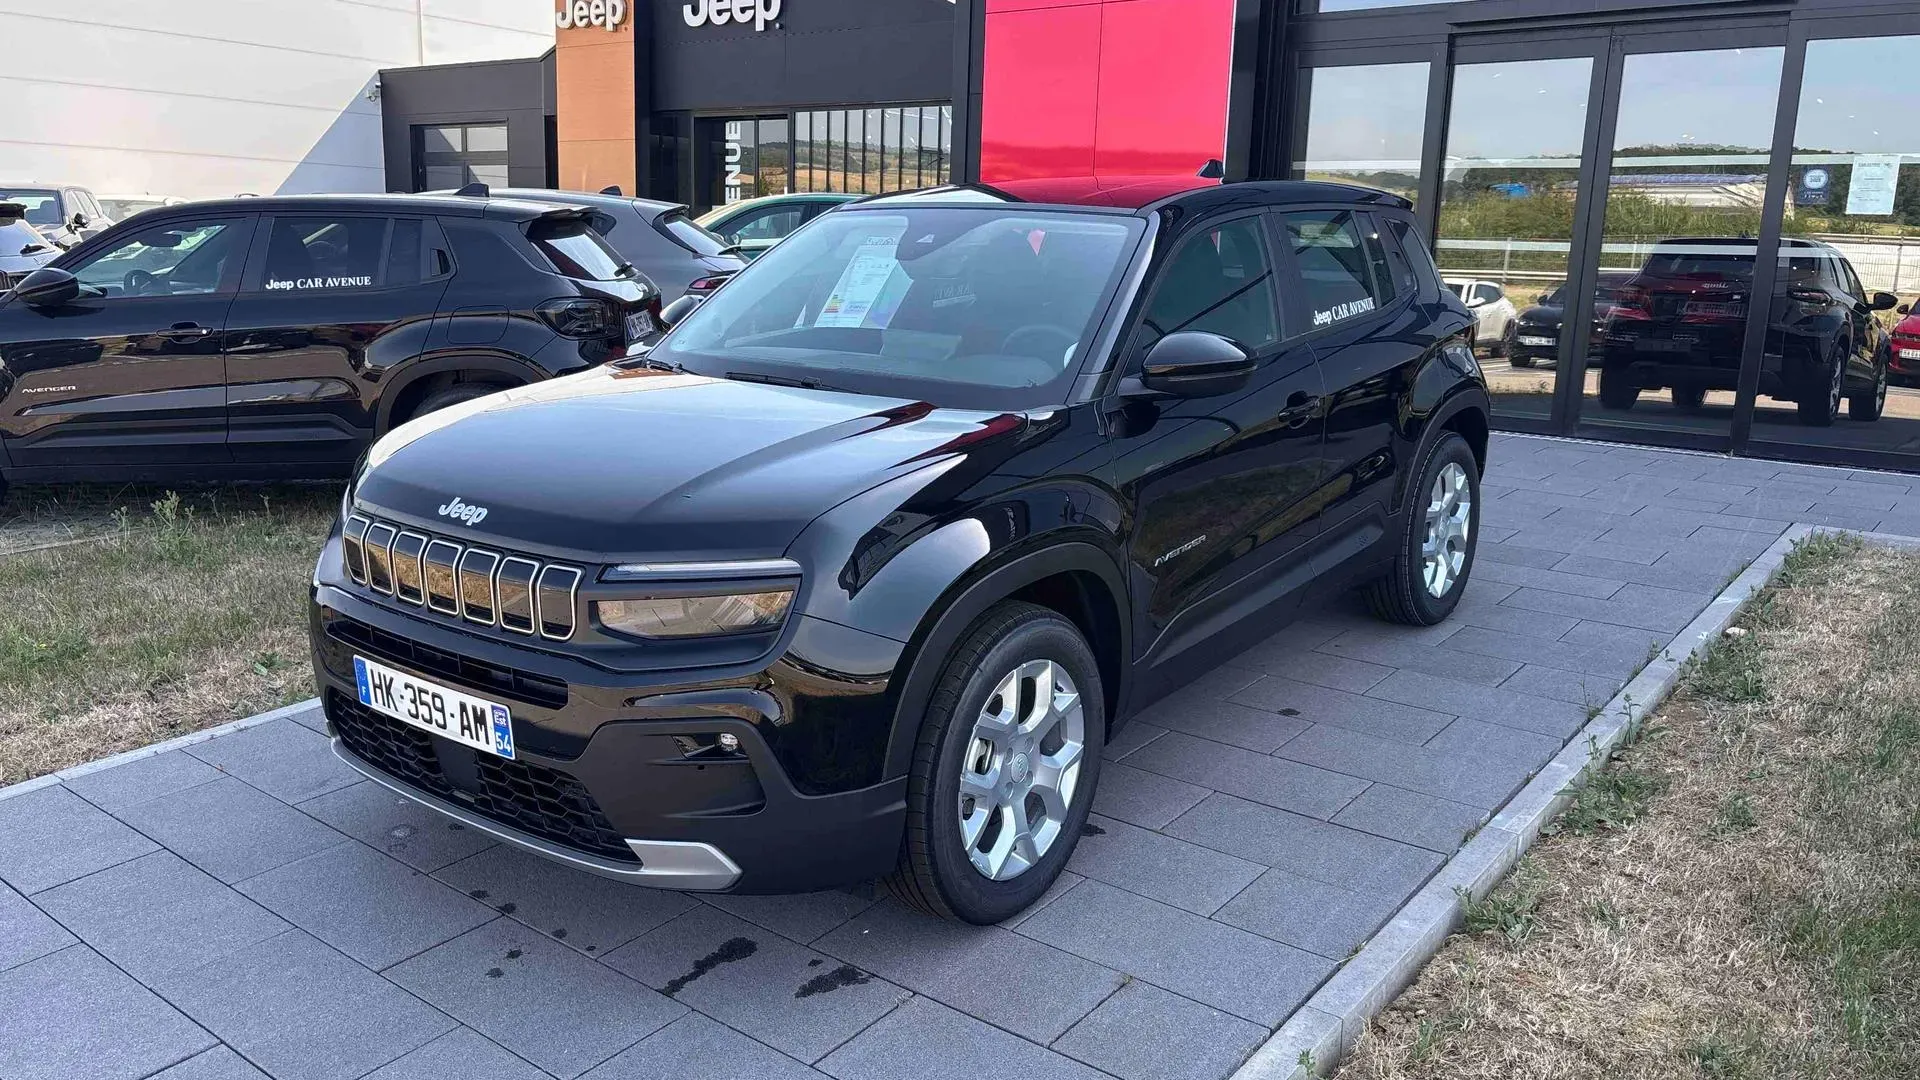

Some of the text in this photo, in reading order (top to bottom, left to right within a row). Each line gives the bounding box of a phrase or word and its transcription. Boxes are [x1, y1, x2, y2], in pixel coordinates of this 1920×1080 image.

[556, 0, 626, 32] Jeep
[683, 0, 781, 32] Jeep
[265, 276, 371, 291] Jeep CAR AVENUE
[1313, 296, 1375, 325] Jeep CAR AVENUE
[22, 385, 76, 394] AVENGER
[438, 497, 488, 525] Jeep
[1154, 534, 1206, 567] AVENGER
[370, 668, 490, 746] HK-359-AM
[494, 715, 507, 726] Est
[495, 731, 512, 753] 54
